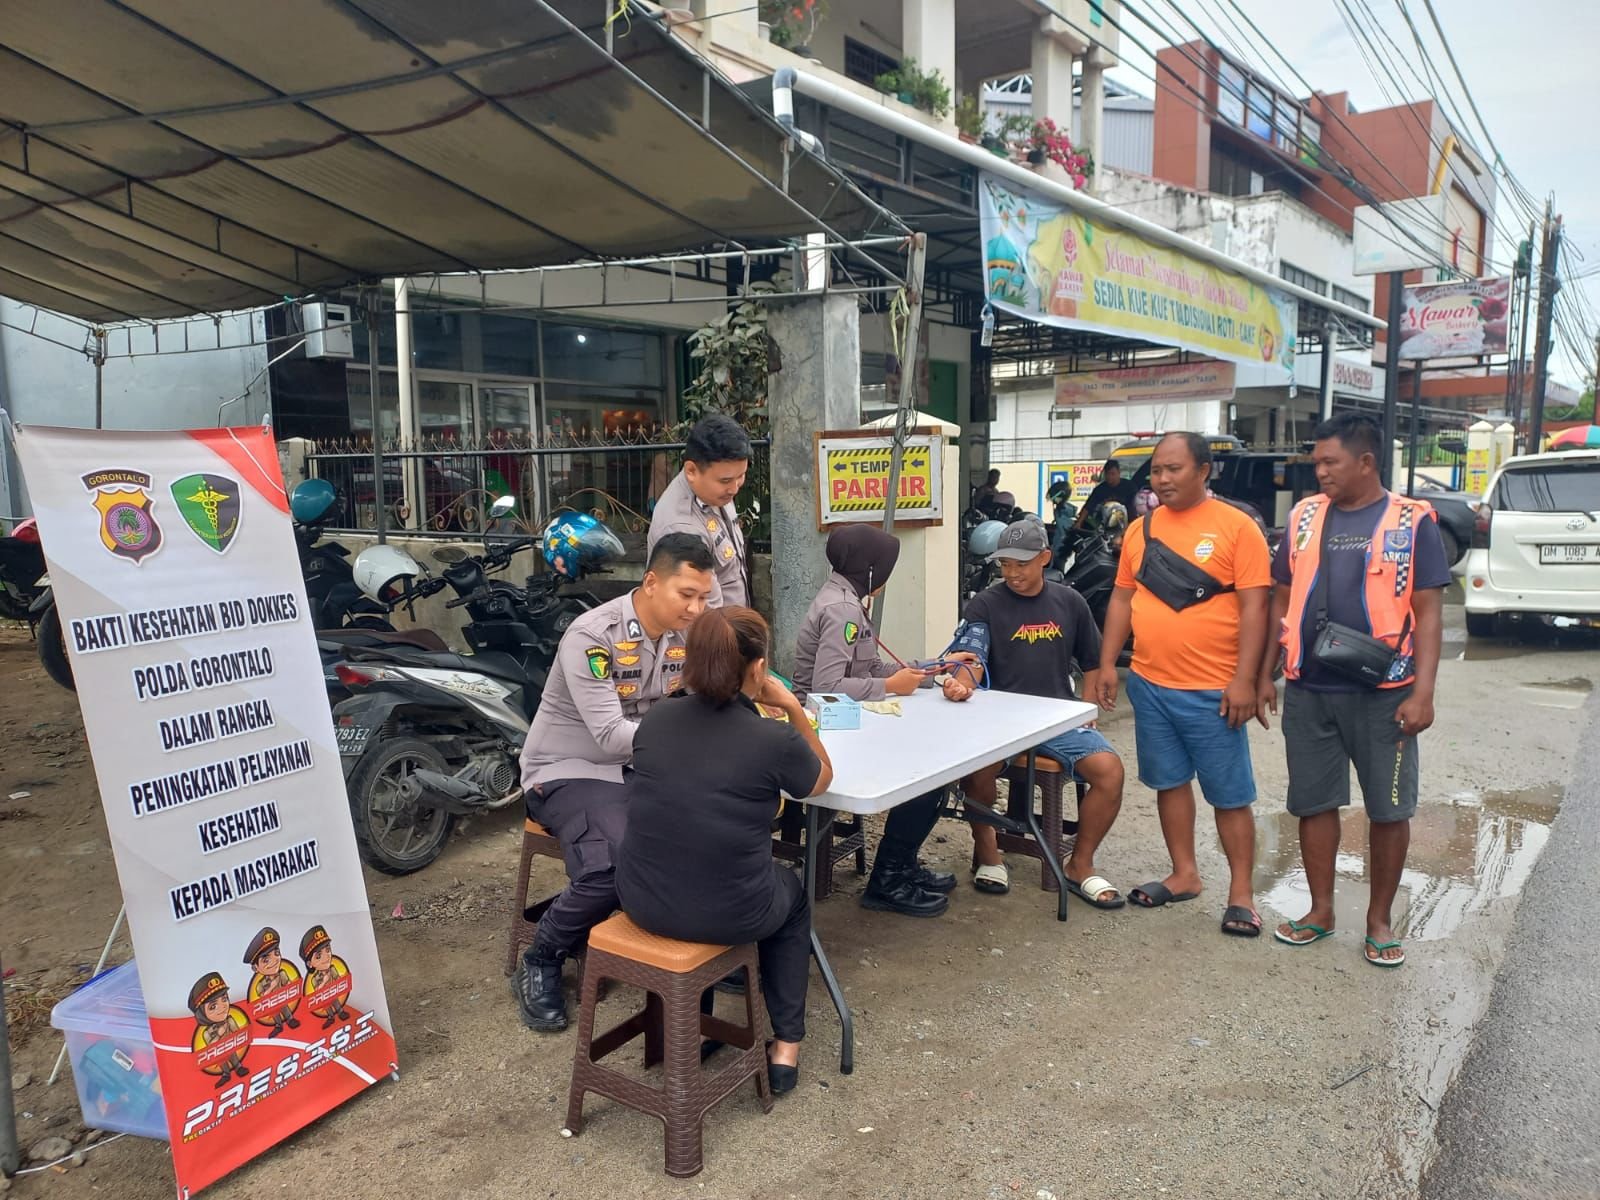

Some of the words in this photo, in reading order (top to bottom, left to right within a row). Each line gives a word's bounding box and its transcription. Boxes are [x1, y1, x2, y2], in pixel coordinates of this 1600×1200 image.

[1094, 279, 1125, 310] SEDIA
[1128, 287, 1148, 316] KUE
[1151, 293, 1168, 320] KUE
[1409, 305, 1474, 330] Mawar
[89, 473, 146, 486] GORONTALO
[851, 460, 907, 473] TEMPT
[1073, 465, 1103, 475] PARK
[1073, 476, 1097, 485] GRA
[1383, 551, 1410, 563] ARKIR
[1565, 545, 1587, 557] 1083
[71, 616, 127, 652] BAKTI
[131, 602, 218, 644] KESEHATAN
[220, 600, 245, 631] BID
[247, 592, 298, 627] DOKKES
[1010, 620, 1063, 645] ANTHRAX
[134, 661, 189, 699] POLDA
[190, 646, 273, 687] GORONTALO
[159, 710, 214, 750] DALAM
[218, 699, 273, 741] RANGKA
[355, 728, 370, 740] EZ
[130, 763, 238, 816] PENINGKATAN
[241, 740, 312, 785] PELAYANAN
[1391, 751, 1402, 806] DUNLOP
[199, 801, 279, 852] KESEHATAN
[171, 877, 232, 920] KEPADA
[236, 840, 319, 894] MASYARAKAT
[252, 980, 301, 1017] PRESISI
[307, 979, 349, 1010] PRESISI
[197, 1031, 249, 1066] PRESISI
[183, 1009, 375, 1137] PRESISI
